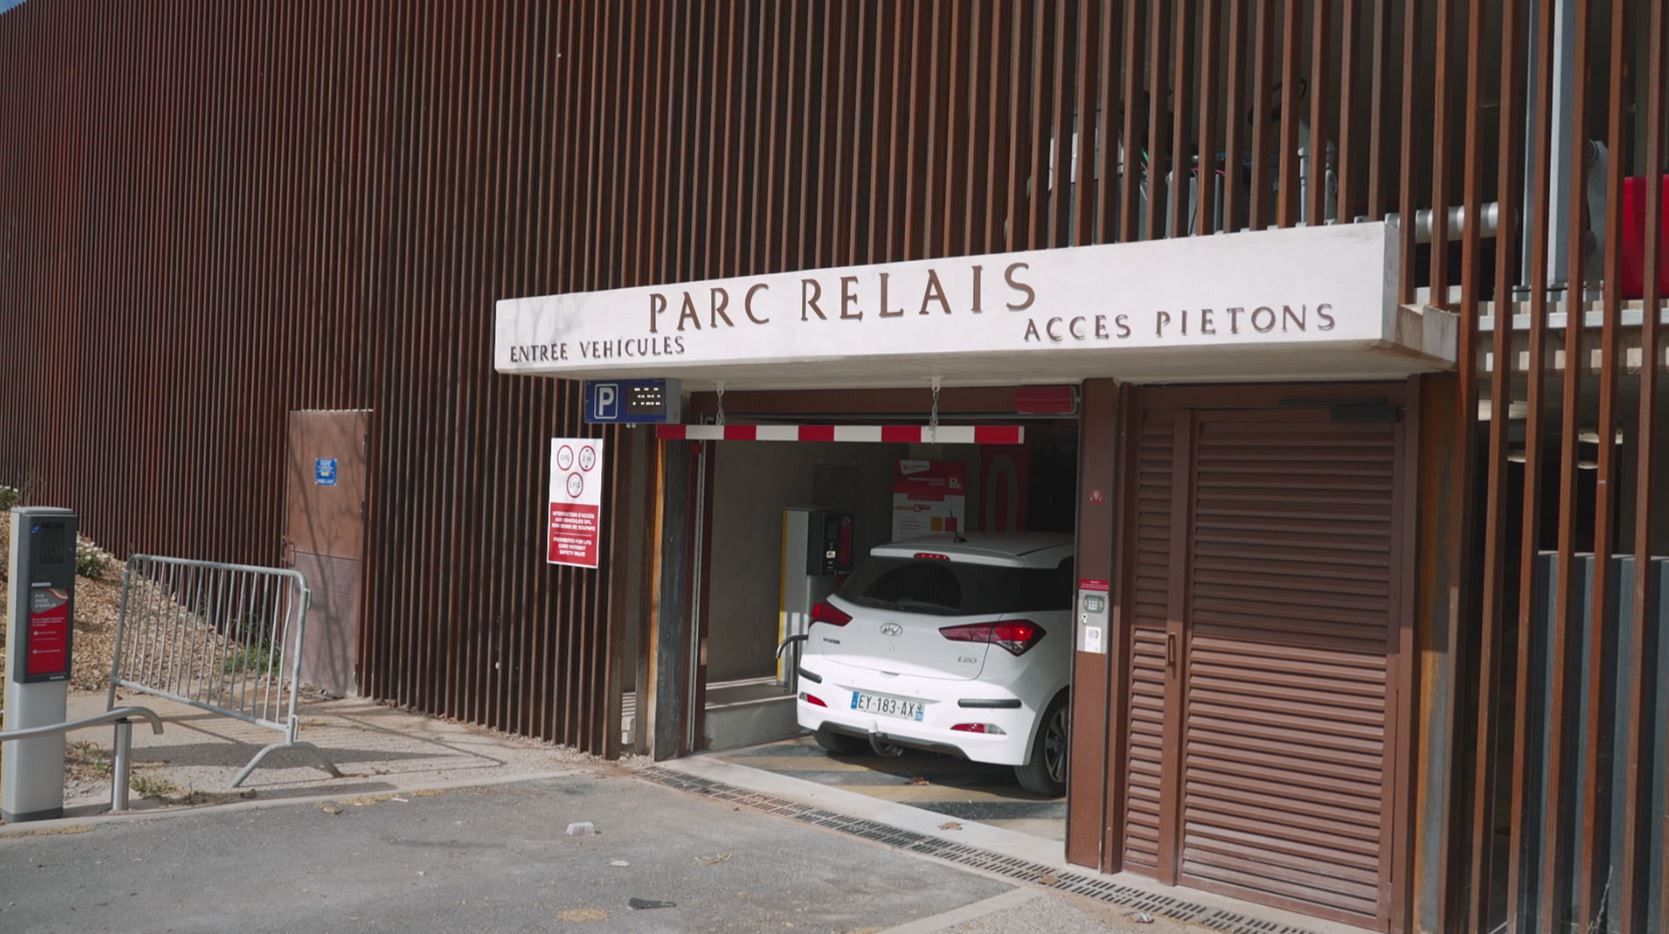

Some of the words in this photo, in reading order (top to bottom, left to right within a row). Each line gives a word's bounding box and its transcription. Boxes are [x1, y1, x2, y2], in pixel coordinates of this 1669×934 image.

[649, 283, 770, 333] PARC
[800, 262, 1038, 322] RELAIS
[1023, 313, 1132, 343] ACCES
[1156, 303, 1336, 338] PIETONS
[510, 341, 568, 364] ENTREE
[580, 336, 685, 360] VEHICULES
[598, 387, 615, 416] P
